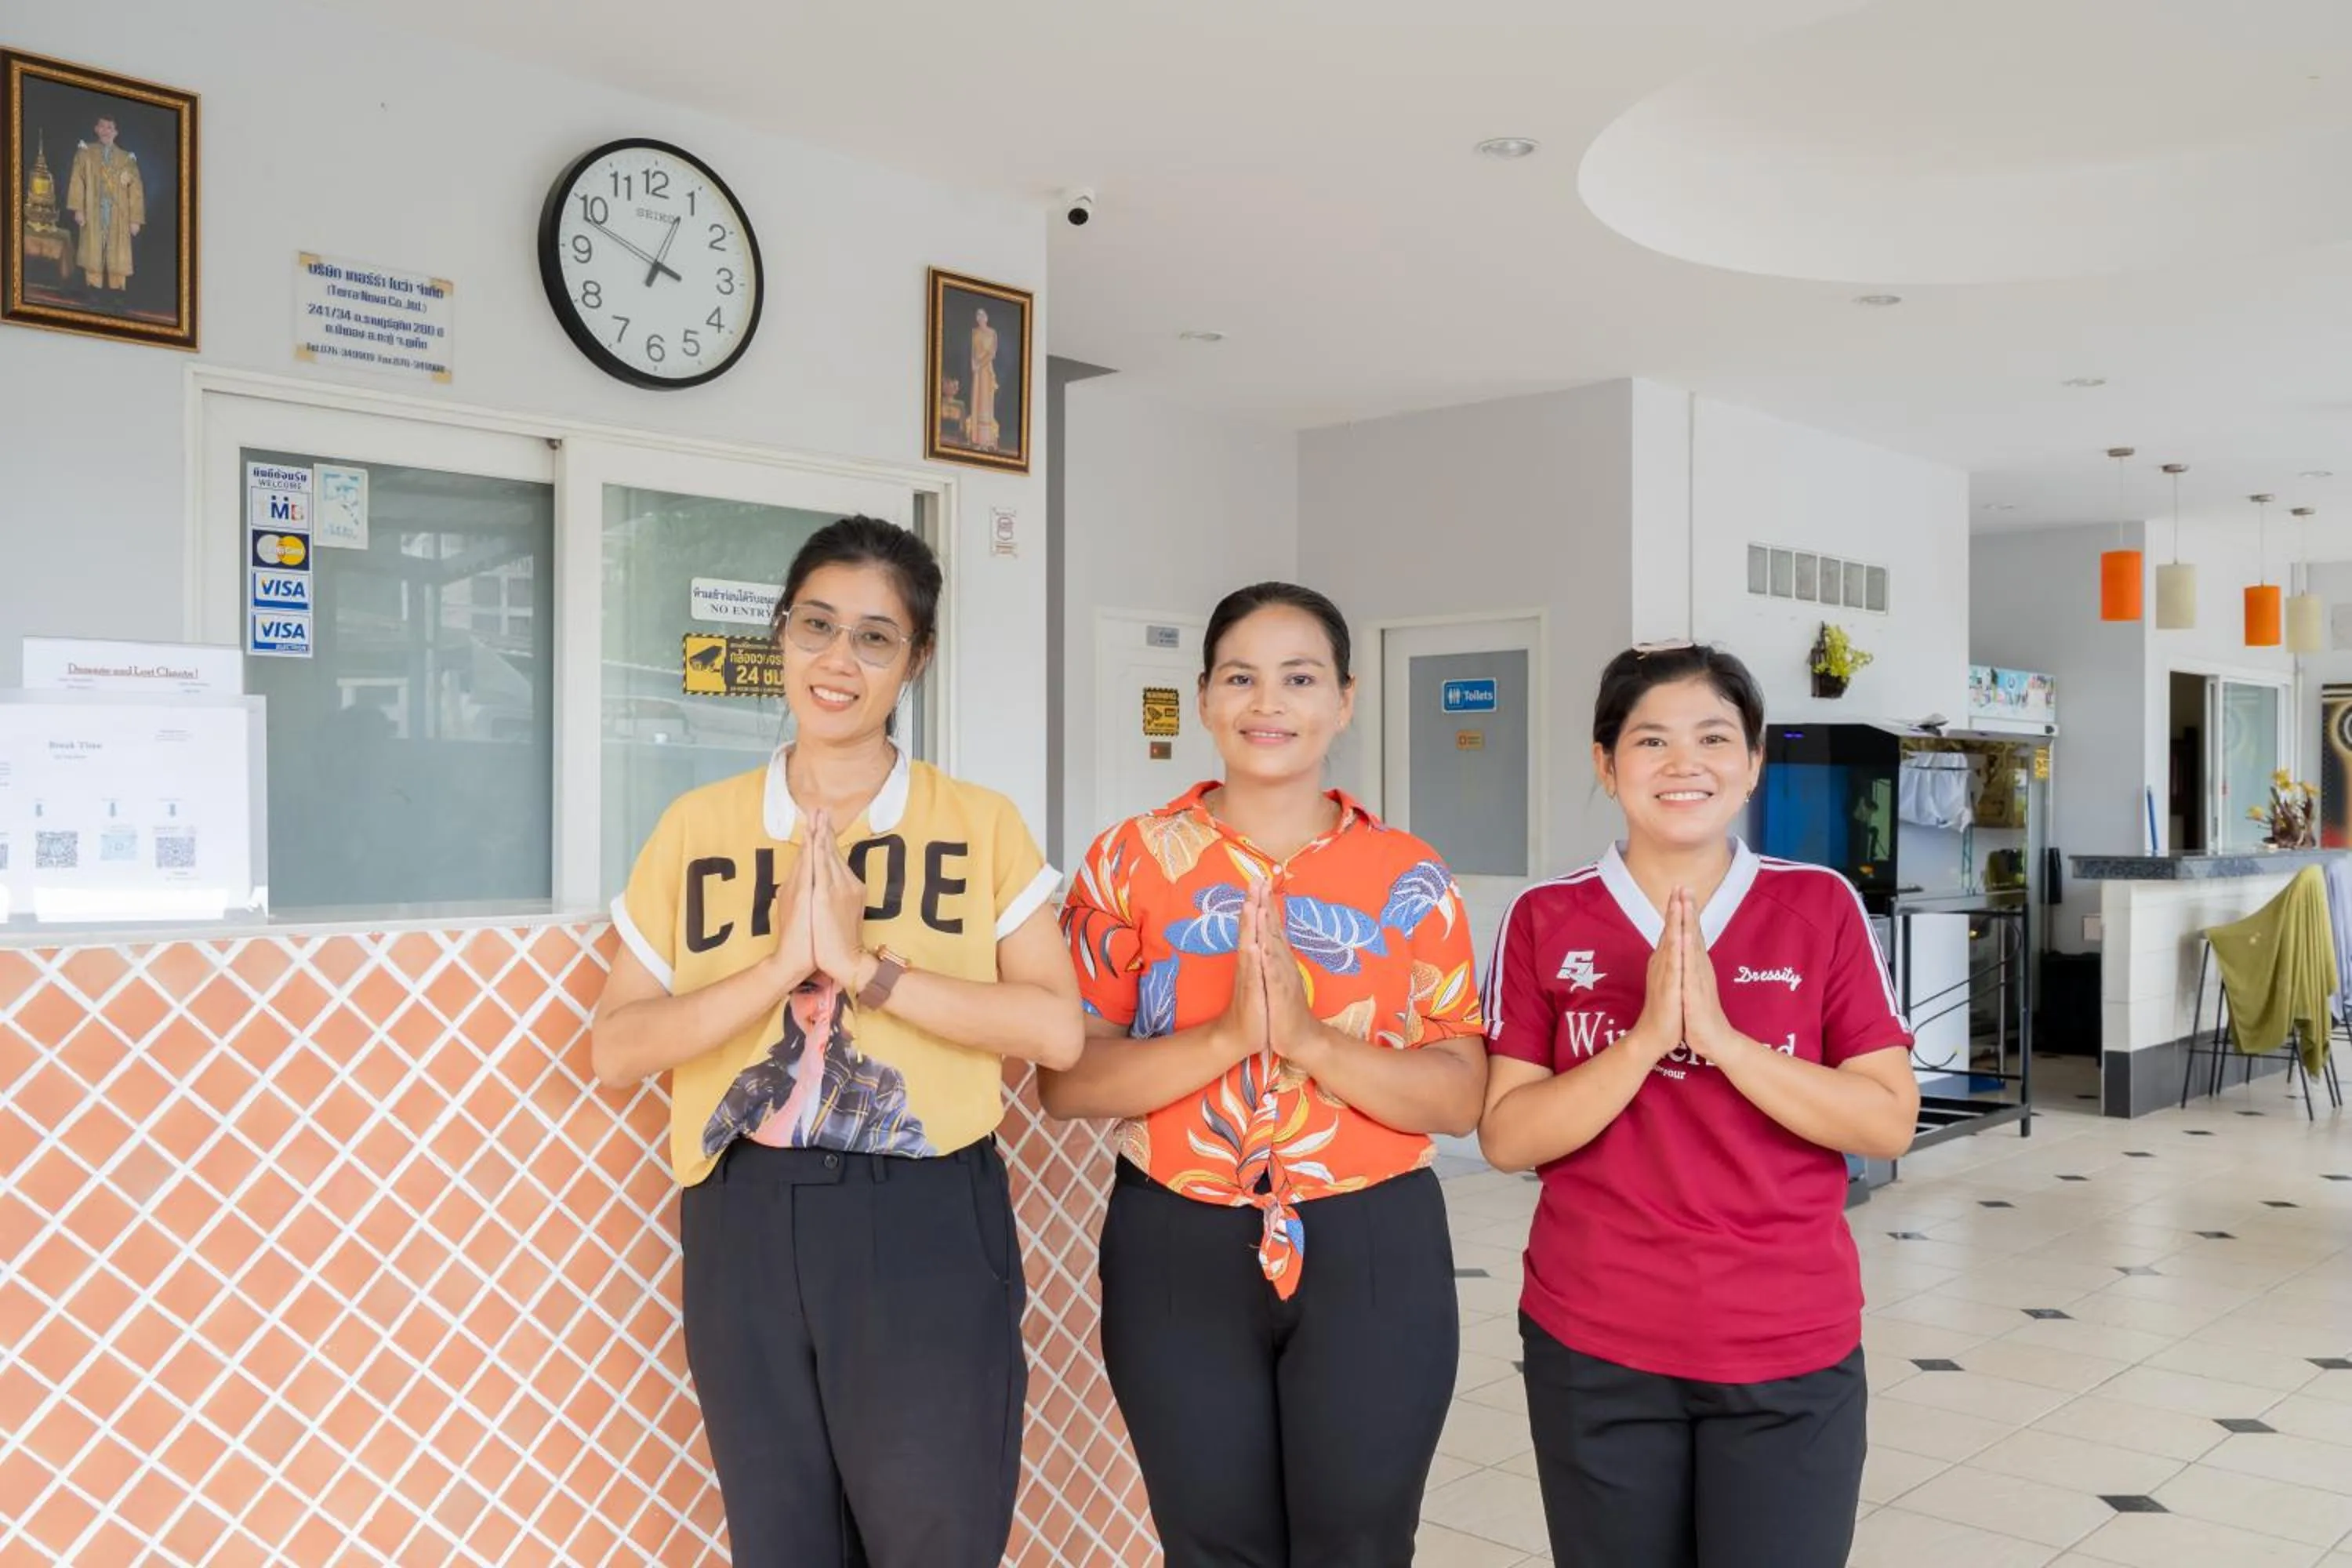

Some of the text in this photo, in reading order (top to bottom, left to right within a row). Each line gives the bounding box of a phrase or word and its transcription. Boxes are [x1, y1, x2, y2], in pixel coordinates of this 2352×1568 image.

[610, 170, 632, 201] 11
[641, 168, 670, 200] 12
[579, 194, 609, 226] 10
[636, 207, 677, 224] SEIKO
[686, 191, 695, 217] 1
[572, 234, 593, 263] 9
[708, 223, 728, 252] 2
[581, 280, 603, 309] 8
[716, 267, 735, 296] 3
[612, 315, 630, 343] 7
[706, 306, 725, 334] 4
[646, 333, 666, 362] 6
[682, 329, 701, 357] 5
[258, 478, 303, 490] WELCOME
[261, 576, 306, 598] VISA
[710, 604, 728, 615] NO
[261, 619, 306, 640] VISA
[736, 666, 759, 684] 24
[1465, 690, 1494, 702] Toilets
[1733, 966, 1802, 992] Dressity
